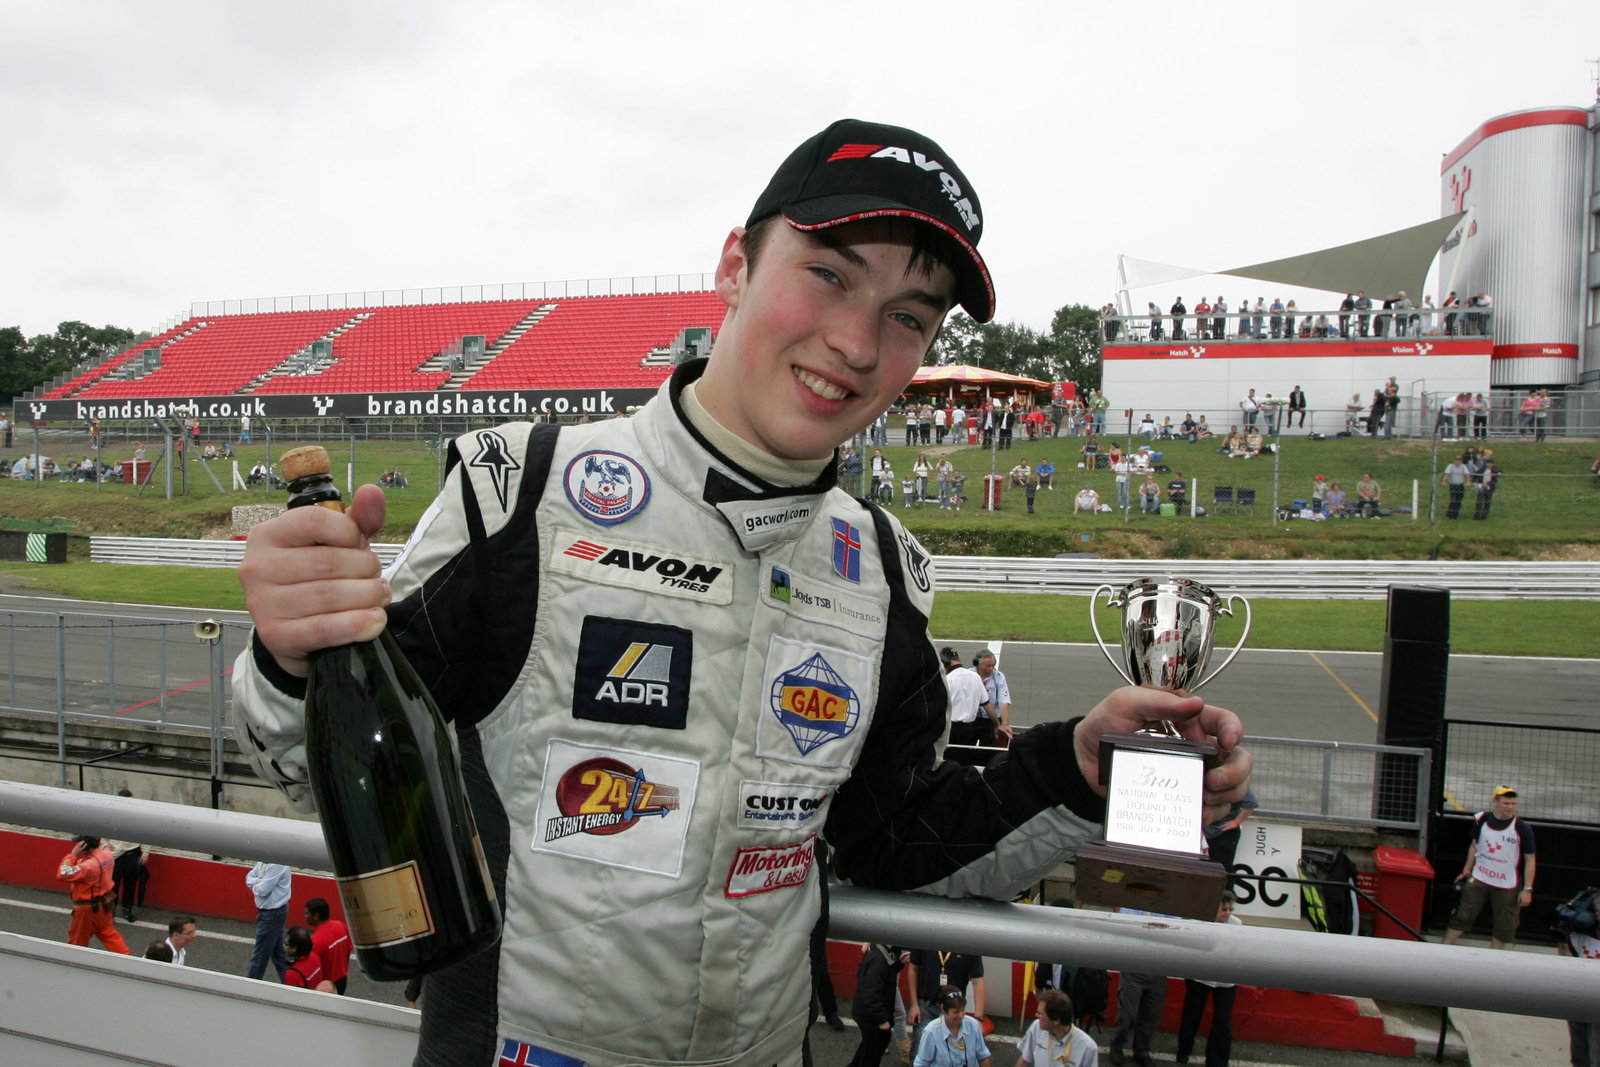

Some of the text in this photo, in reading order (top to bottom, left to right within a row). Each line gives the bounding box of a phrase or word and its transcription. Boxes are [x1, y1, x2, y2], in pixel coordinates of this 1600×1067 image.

[870, 146, 980, 226] AVON
[941, 184, 973, 231] TYRES
[368, 391, 615, 415] brandshatch.co.uk
[598, 549, 723, 584] AVON
[660, 577, 710, 593] TYRES
[814, 596, 831, 609] TSB
[839, 603, 881, 624] Insurance
[595, 680, 669, 707] ADR
[790, 689, 839, 720] GAC
[1126, 800, 1183, 815] ROUND 11
[1164, 792, 1193, 804] CLASS
[546, 813, 622, 841] INSTANT ENERGY
[1116, 810, 1192, 828] BRANDS HATCH
[1138, 825, 1161, 834] JULY
[1166, 828, 1191, 838] 2007
[1501, 835, 1516, 844] 140
[737, 844, 813, 875] Motoring
[1478, 865, 1506, 880] MEDIA
